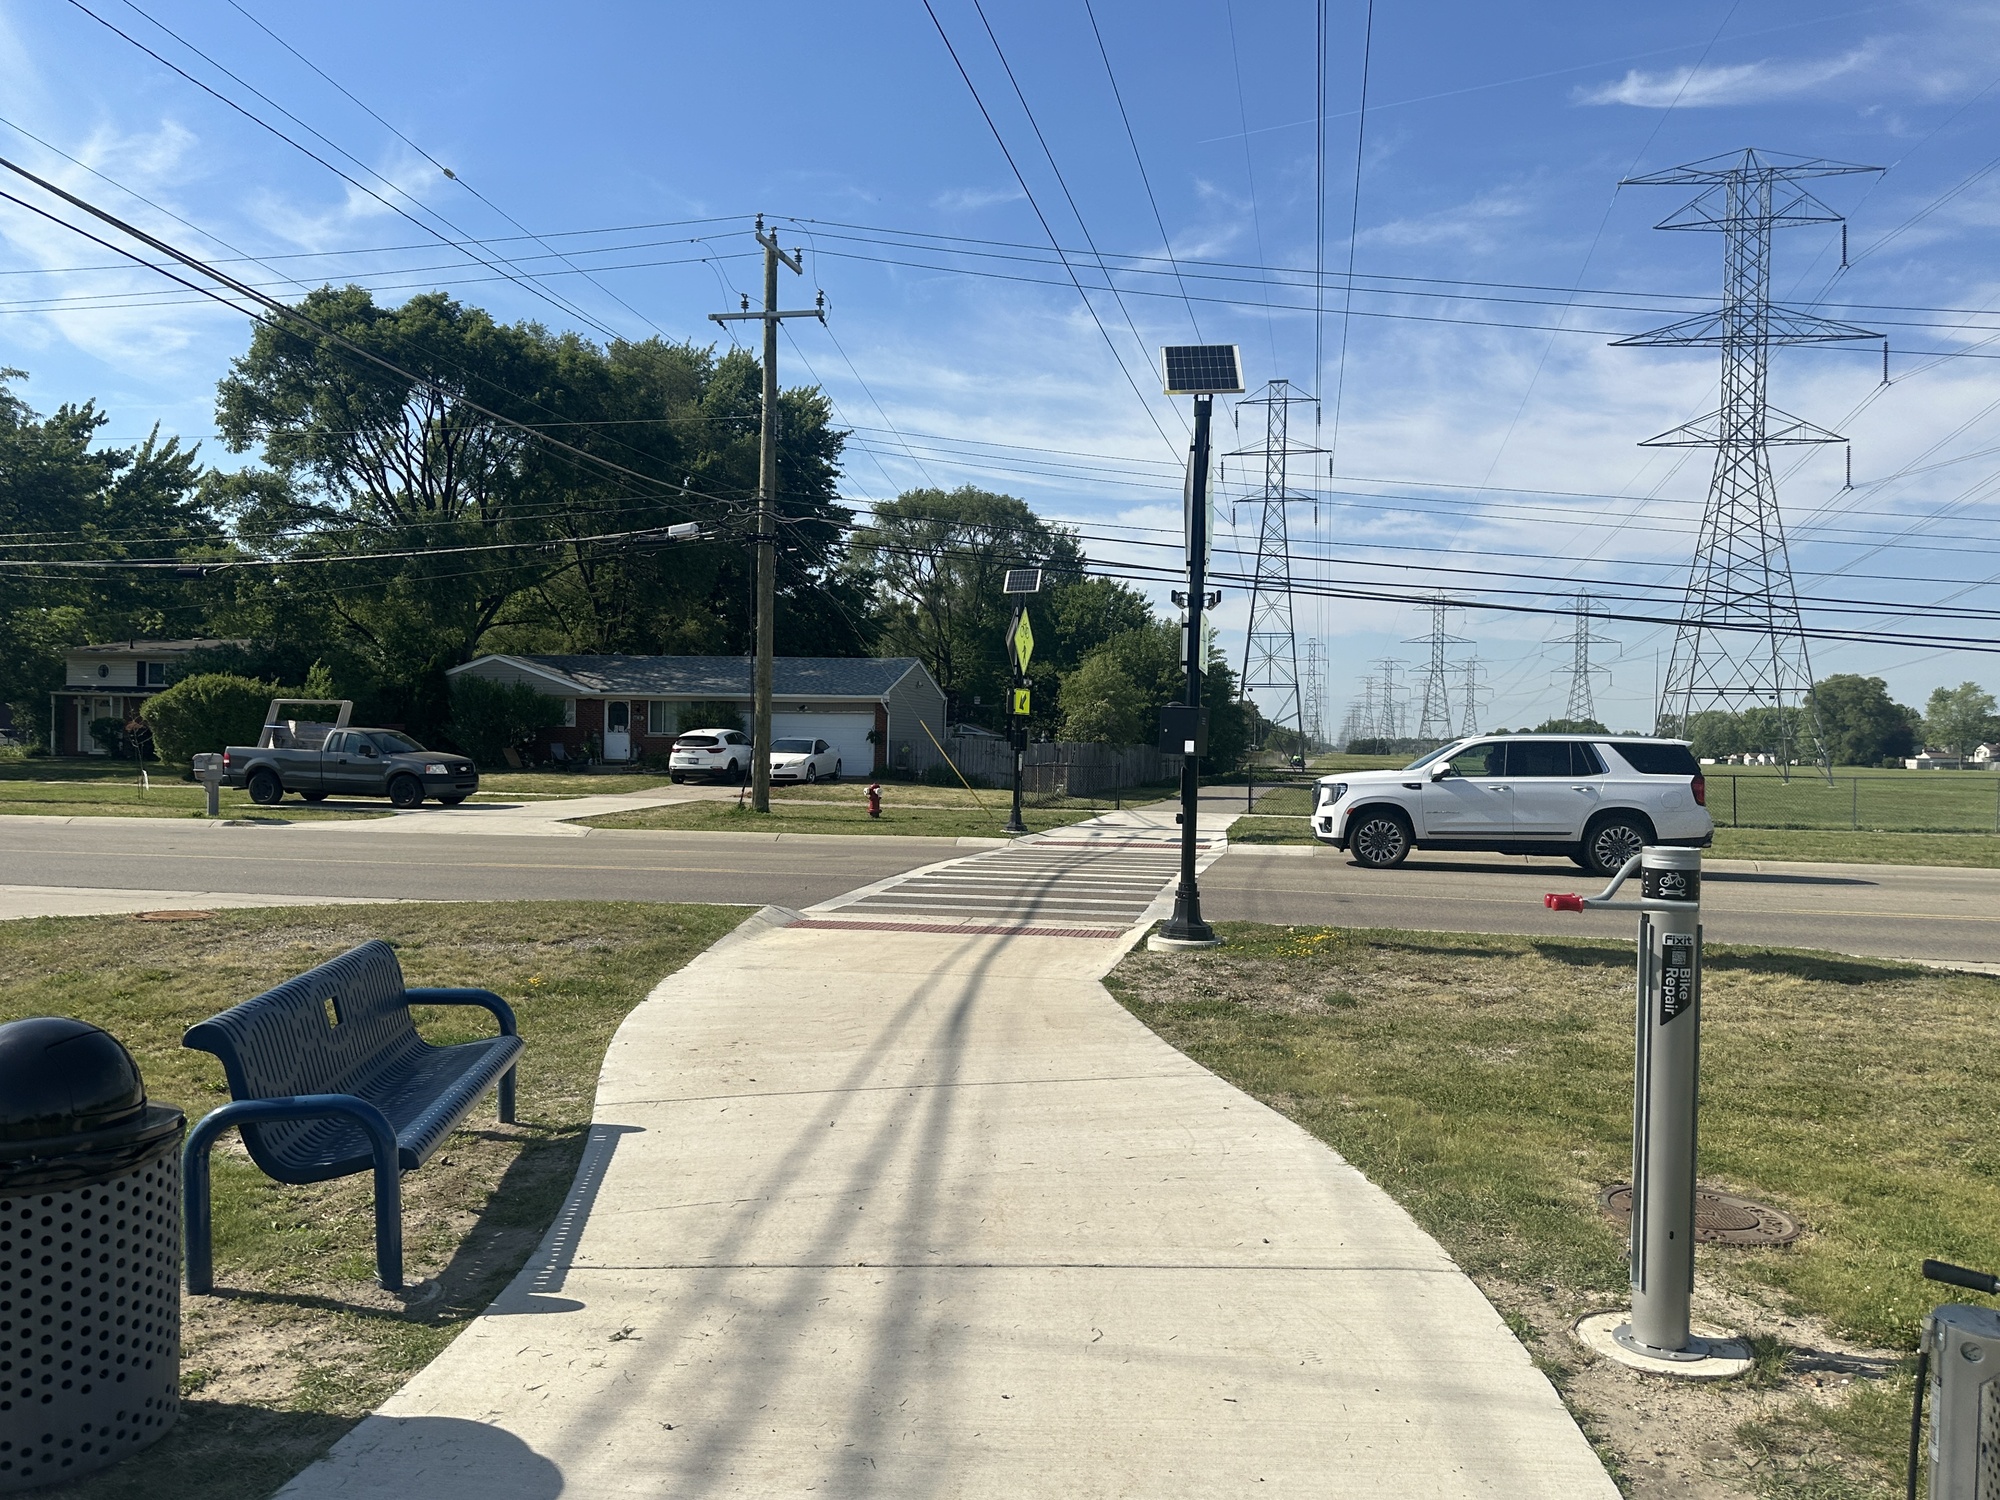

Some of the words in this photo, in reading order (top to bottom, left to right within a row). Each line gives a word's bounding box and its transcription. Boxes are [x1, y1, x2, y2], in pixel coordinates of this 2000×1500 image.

[1665, 935, 1692, 945] Fixit
[1663, 967, 1679, 1015] Repair
[1679, 968, 1691, 1000] Bike
